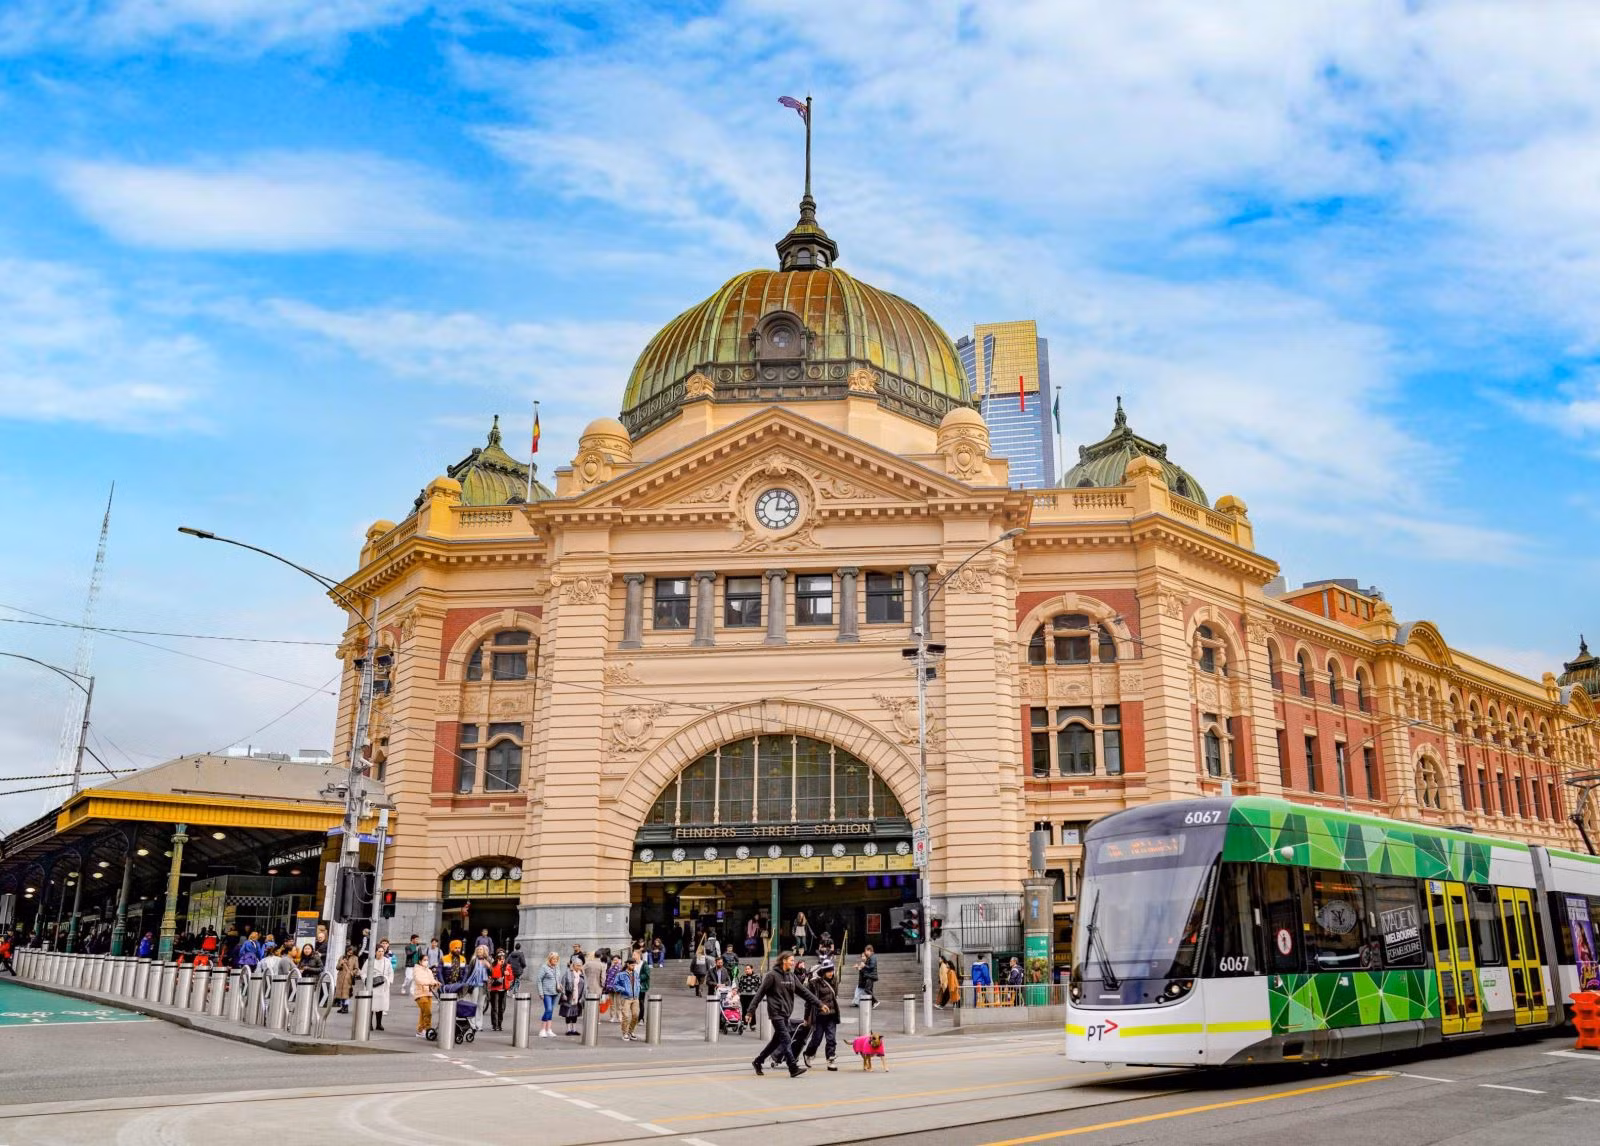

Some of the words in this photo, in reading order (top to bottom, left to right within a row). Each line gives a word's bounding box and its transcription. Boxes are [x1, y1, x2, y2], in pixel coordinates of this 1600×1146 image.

[1184, 810, 1222, 824] 6067
[675, 827, 737, 838] FLINDERS
[752, 825, 799, 837] STREET
[814, 824, 871, 835] STATION
[1386, 927, 1418, 945] MELBOURNE
[1396, 941, 1421, 956] MELBOURNE
[1220, 956, 1249, 972] 6067
